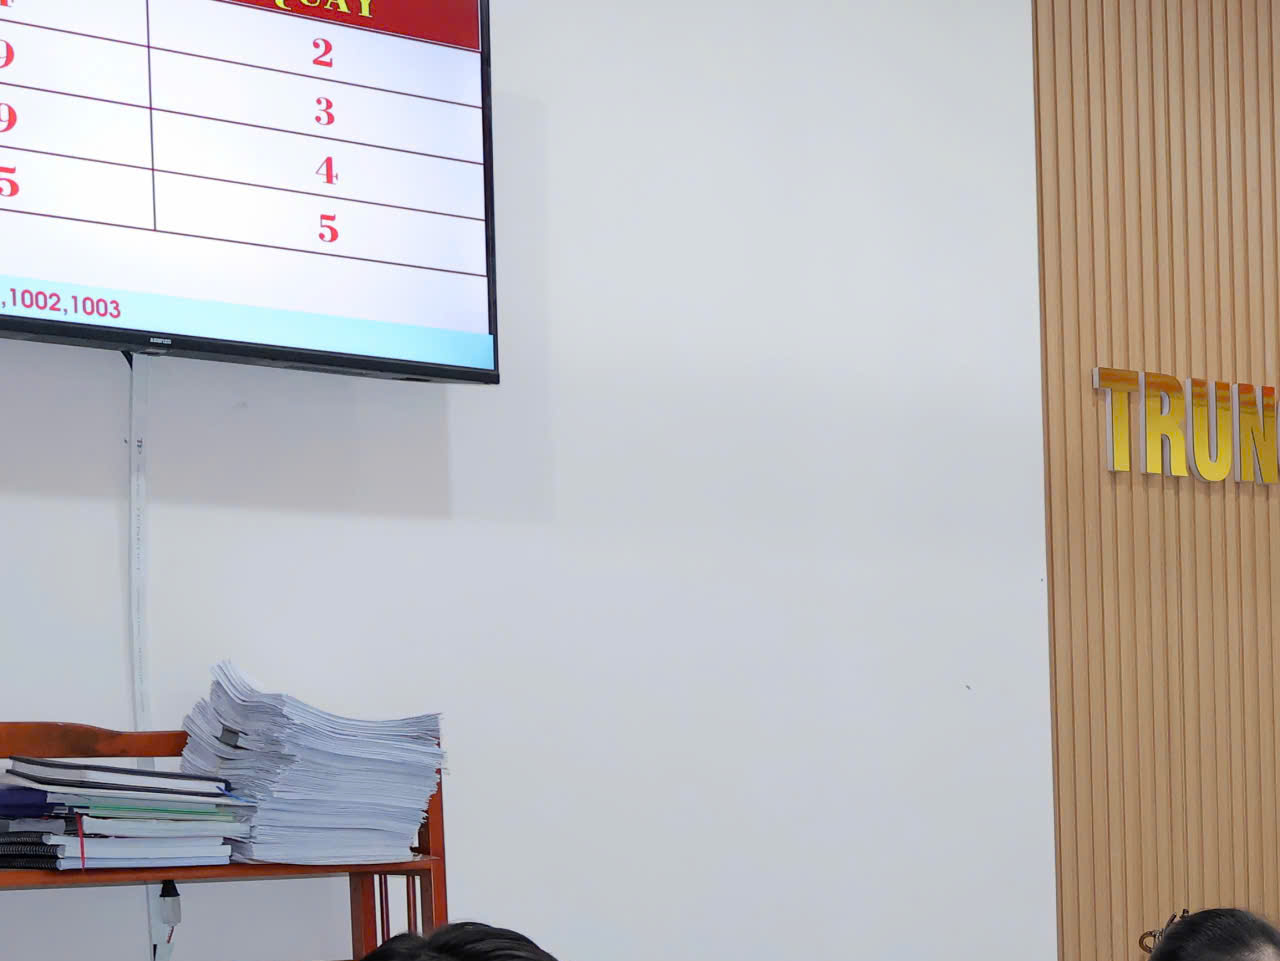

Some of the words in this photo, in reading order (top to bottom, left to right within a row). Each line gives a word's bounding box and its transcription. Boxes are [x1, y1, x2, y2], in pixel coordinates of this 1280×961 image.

[312, 37, 334, 68] 2
[315, 97, 336, 126] 3
[315, 156, 339, 185] 4
[318, 214, 339, 243] 5
